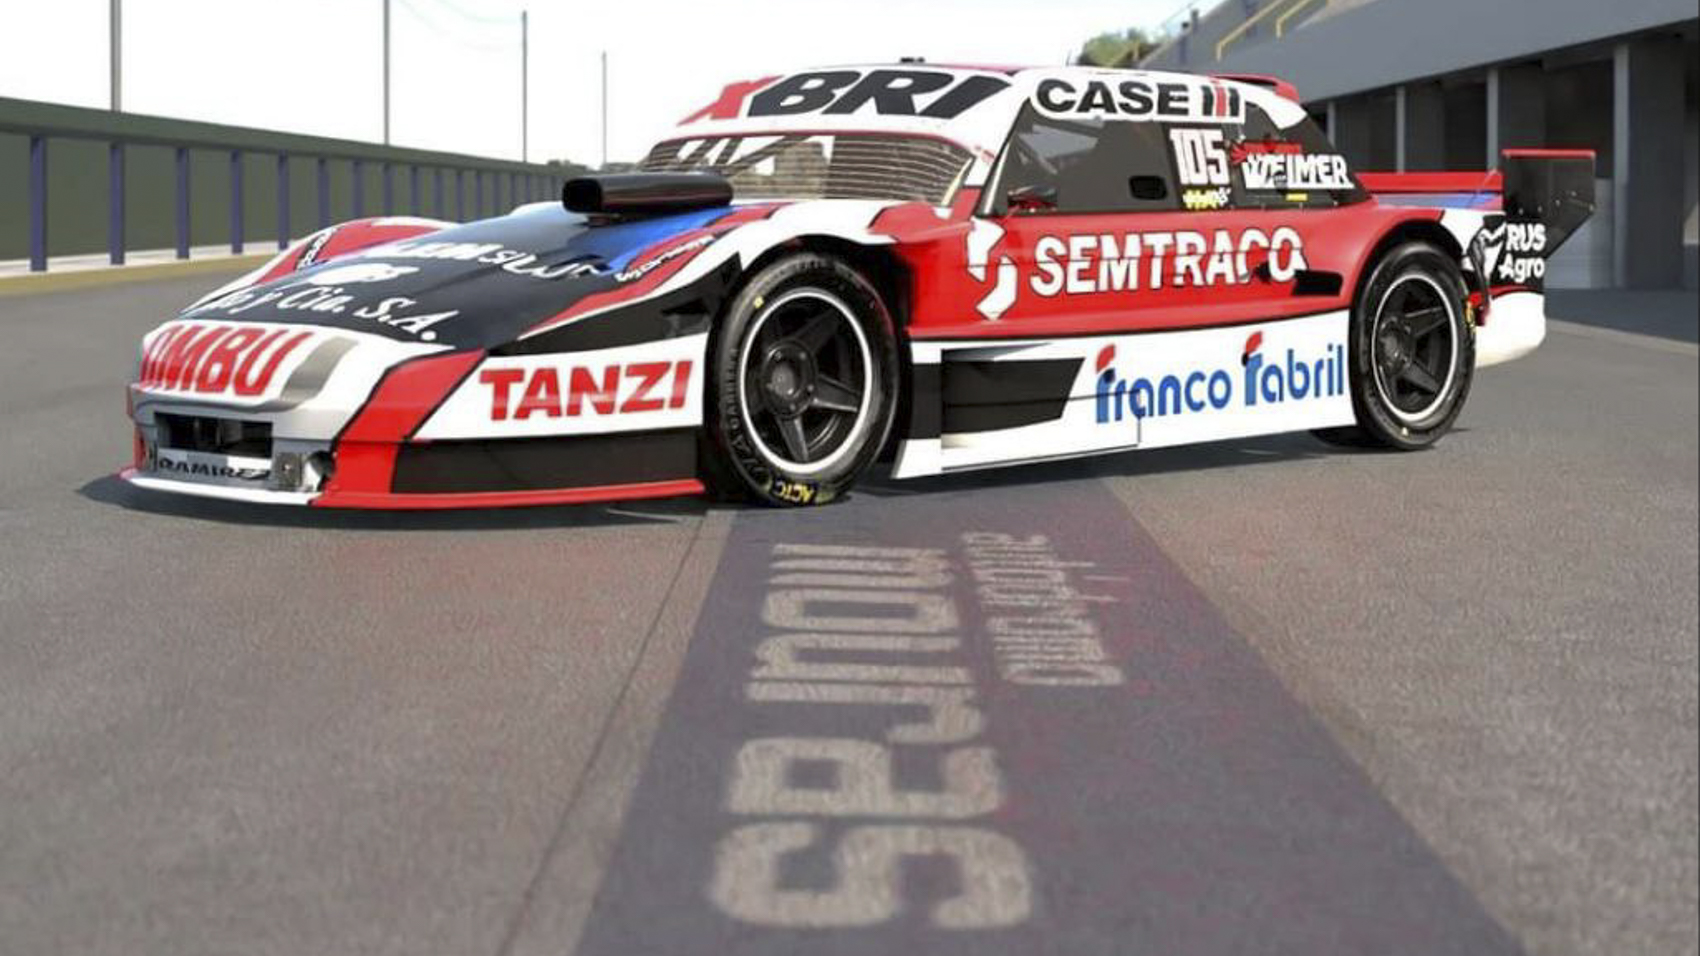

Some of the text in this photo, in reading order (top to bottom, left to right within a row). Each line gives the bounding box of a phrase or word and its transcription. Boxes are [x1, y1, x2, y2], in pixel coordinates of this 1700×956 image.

[676, 69, 1012, 127] XBRI
[1036, 79, 1190, 115] CASE
[1169, 128, 1230, 185] 105
[1241, 153, 1355, 189] WEIMER
[1505, 223, 1546, 251] RUS
[1030, 226, 1307, 298] SEMTRACO
[1498, 252, 1545, 283] Agro
[479, 360, 693, 421] TANZI
